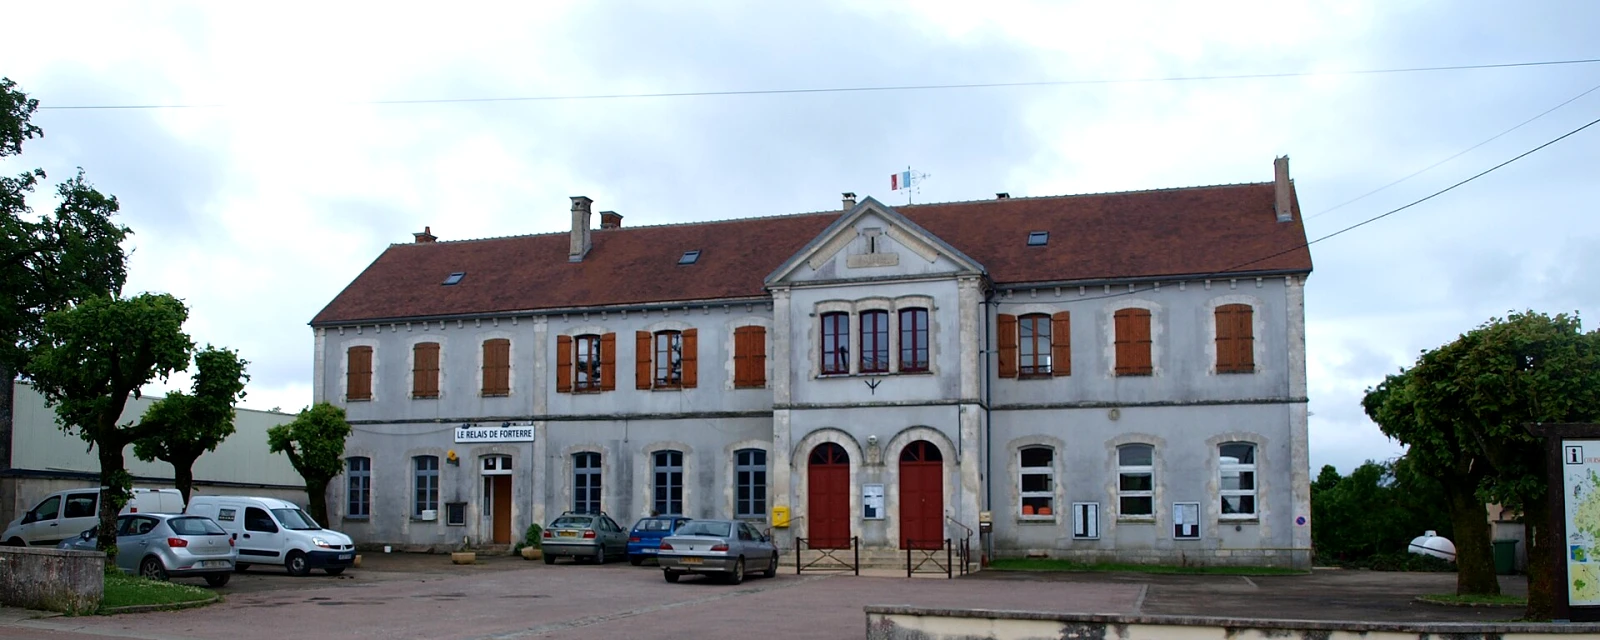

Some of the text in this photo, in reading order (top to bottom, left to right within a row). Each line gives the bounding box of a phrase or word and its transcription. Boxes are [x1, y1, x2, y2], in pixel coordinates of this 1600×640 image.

[466, 430, 488, 438] RELAIS
[489, 430, 498, 438] DE
[499, 429, 532, 438] FORTERRE
